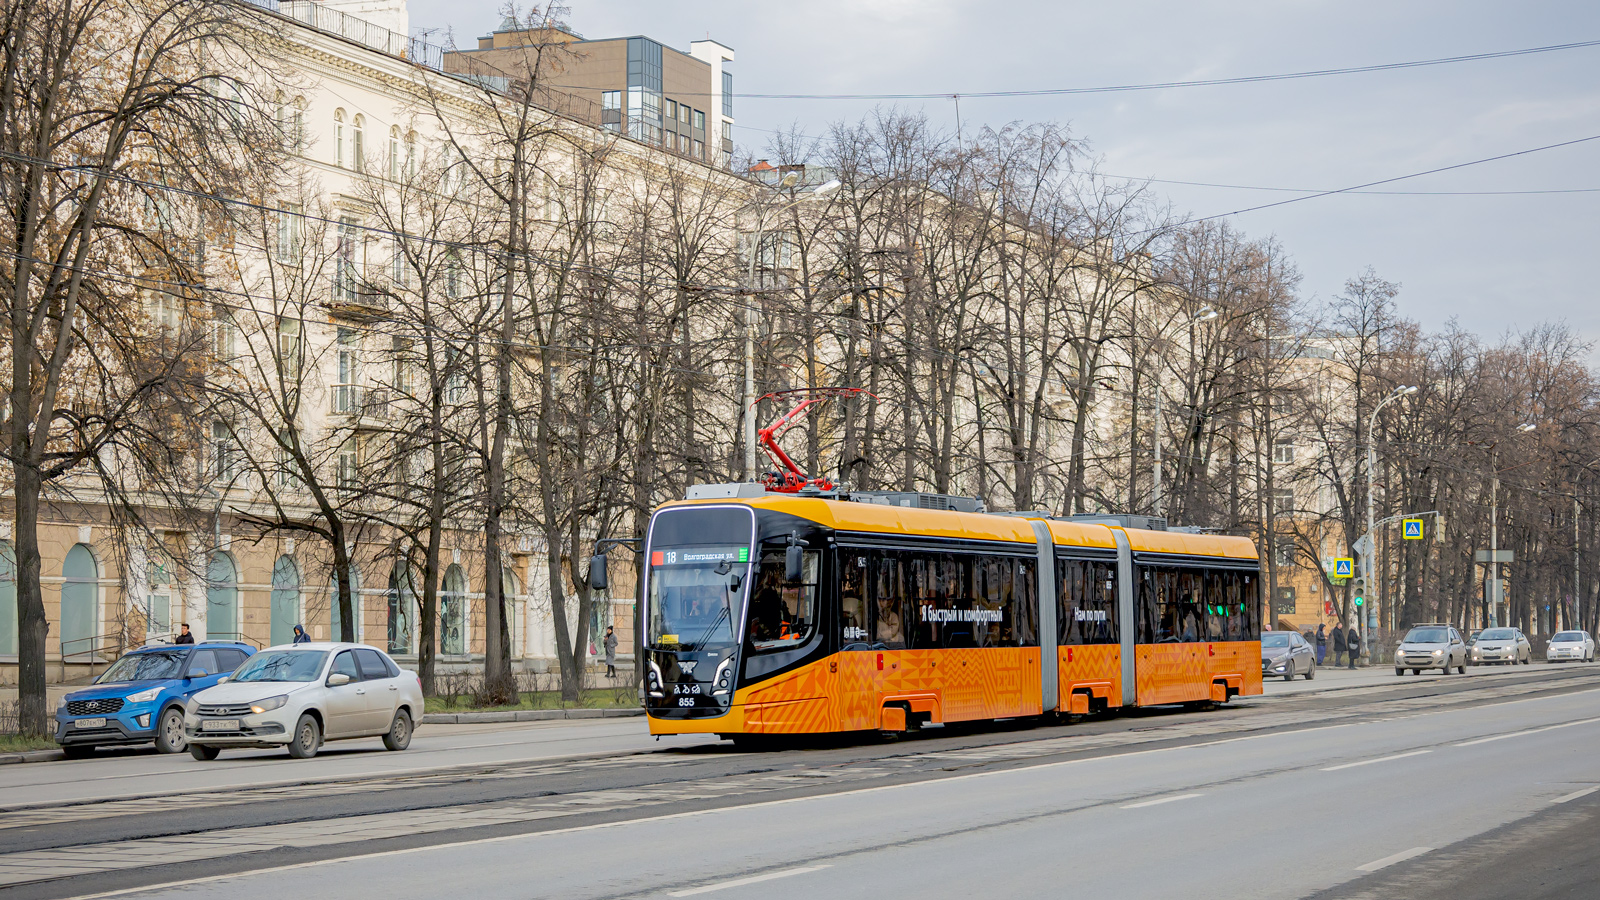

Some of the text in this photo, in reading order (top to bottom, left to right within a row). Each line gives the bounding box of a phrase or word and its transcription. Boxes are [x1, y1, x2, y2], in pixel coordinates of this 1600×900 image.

[666, 551, 677, 564] 18
[683, 553, 725, 562] Волгоградская
[921, 604, 1003, 626] Я быстрый и комфортный
[1074, 606, 1106, 625] Нам по пути
[678, 697, 695, 707] 855
